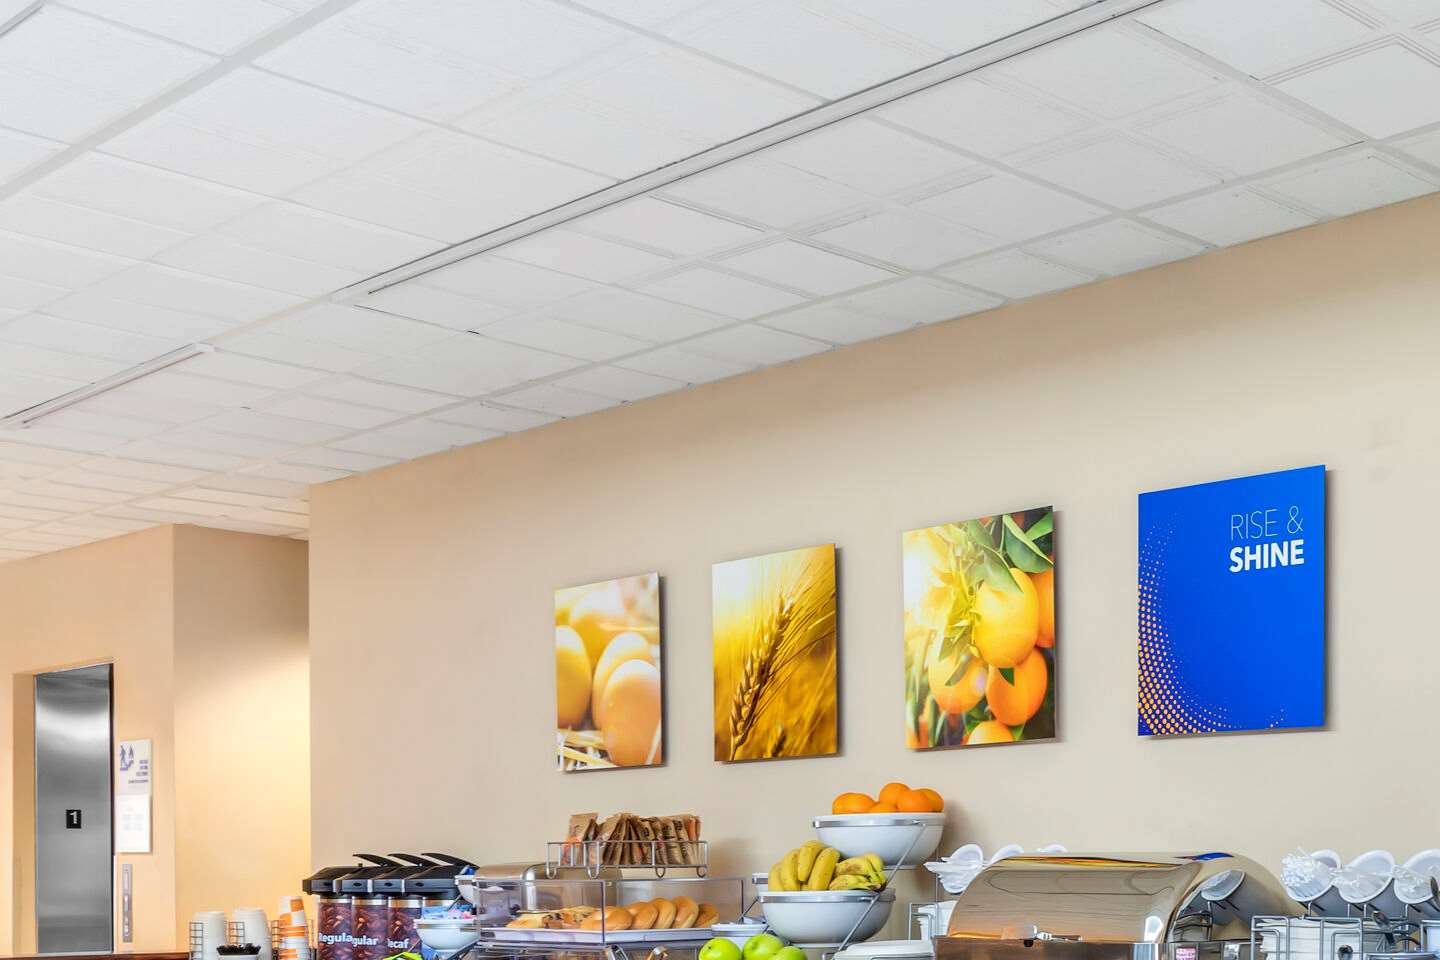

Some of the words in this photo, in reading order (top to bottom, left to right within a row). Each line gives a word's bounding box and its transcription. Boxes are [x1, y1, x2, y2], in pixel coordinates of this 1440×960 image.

[1230, 508, 1279, 541] RISE
[1286, 505, 1304, 534] &
[1229, 539, 1305, 573] SHINE
[70, 811, 78, 824] 1
[388, 938, 410, 949] ecaf
